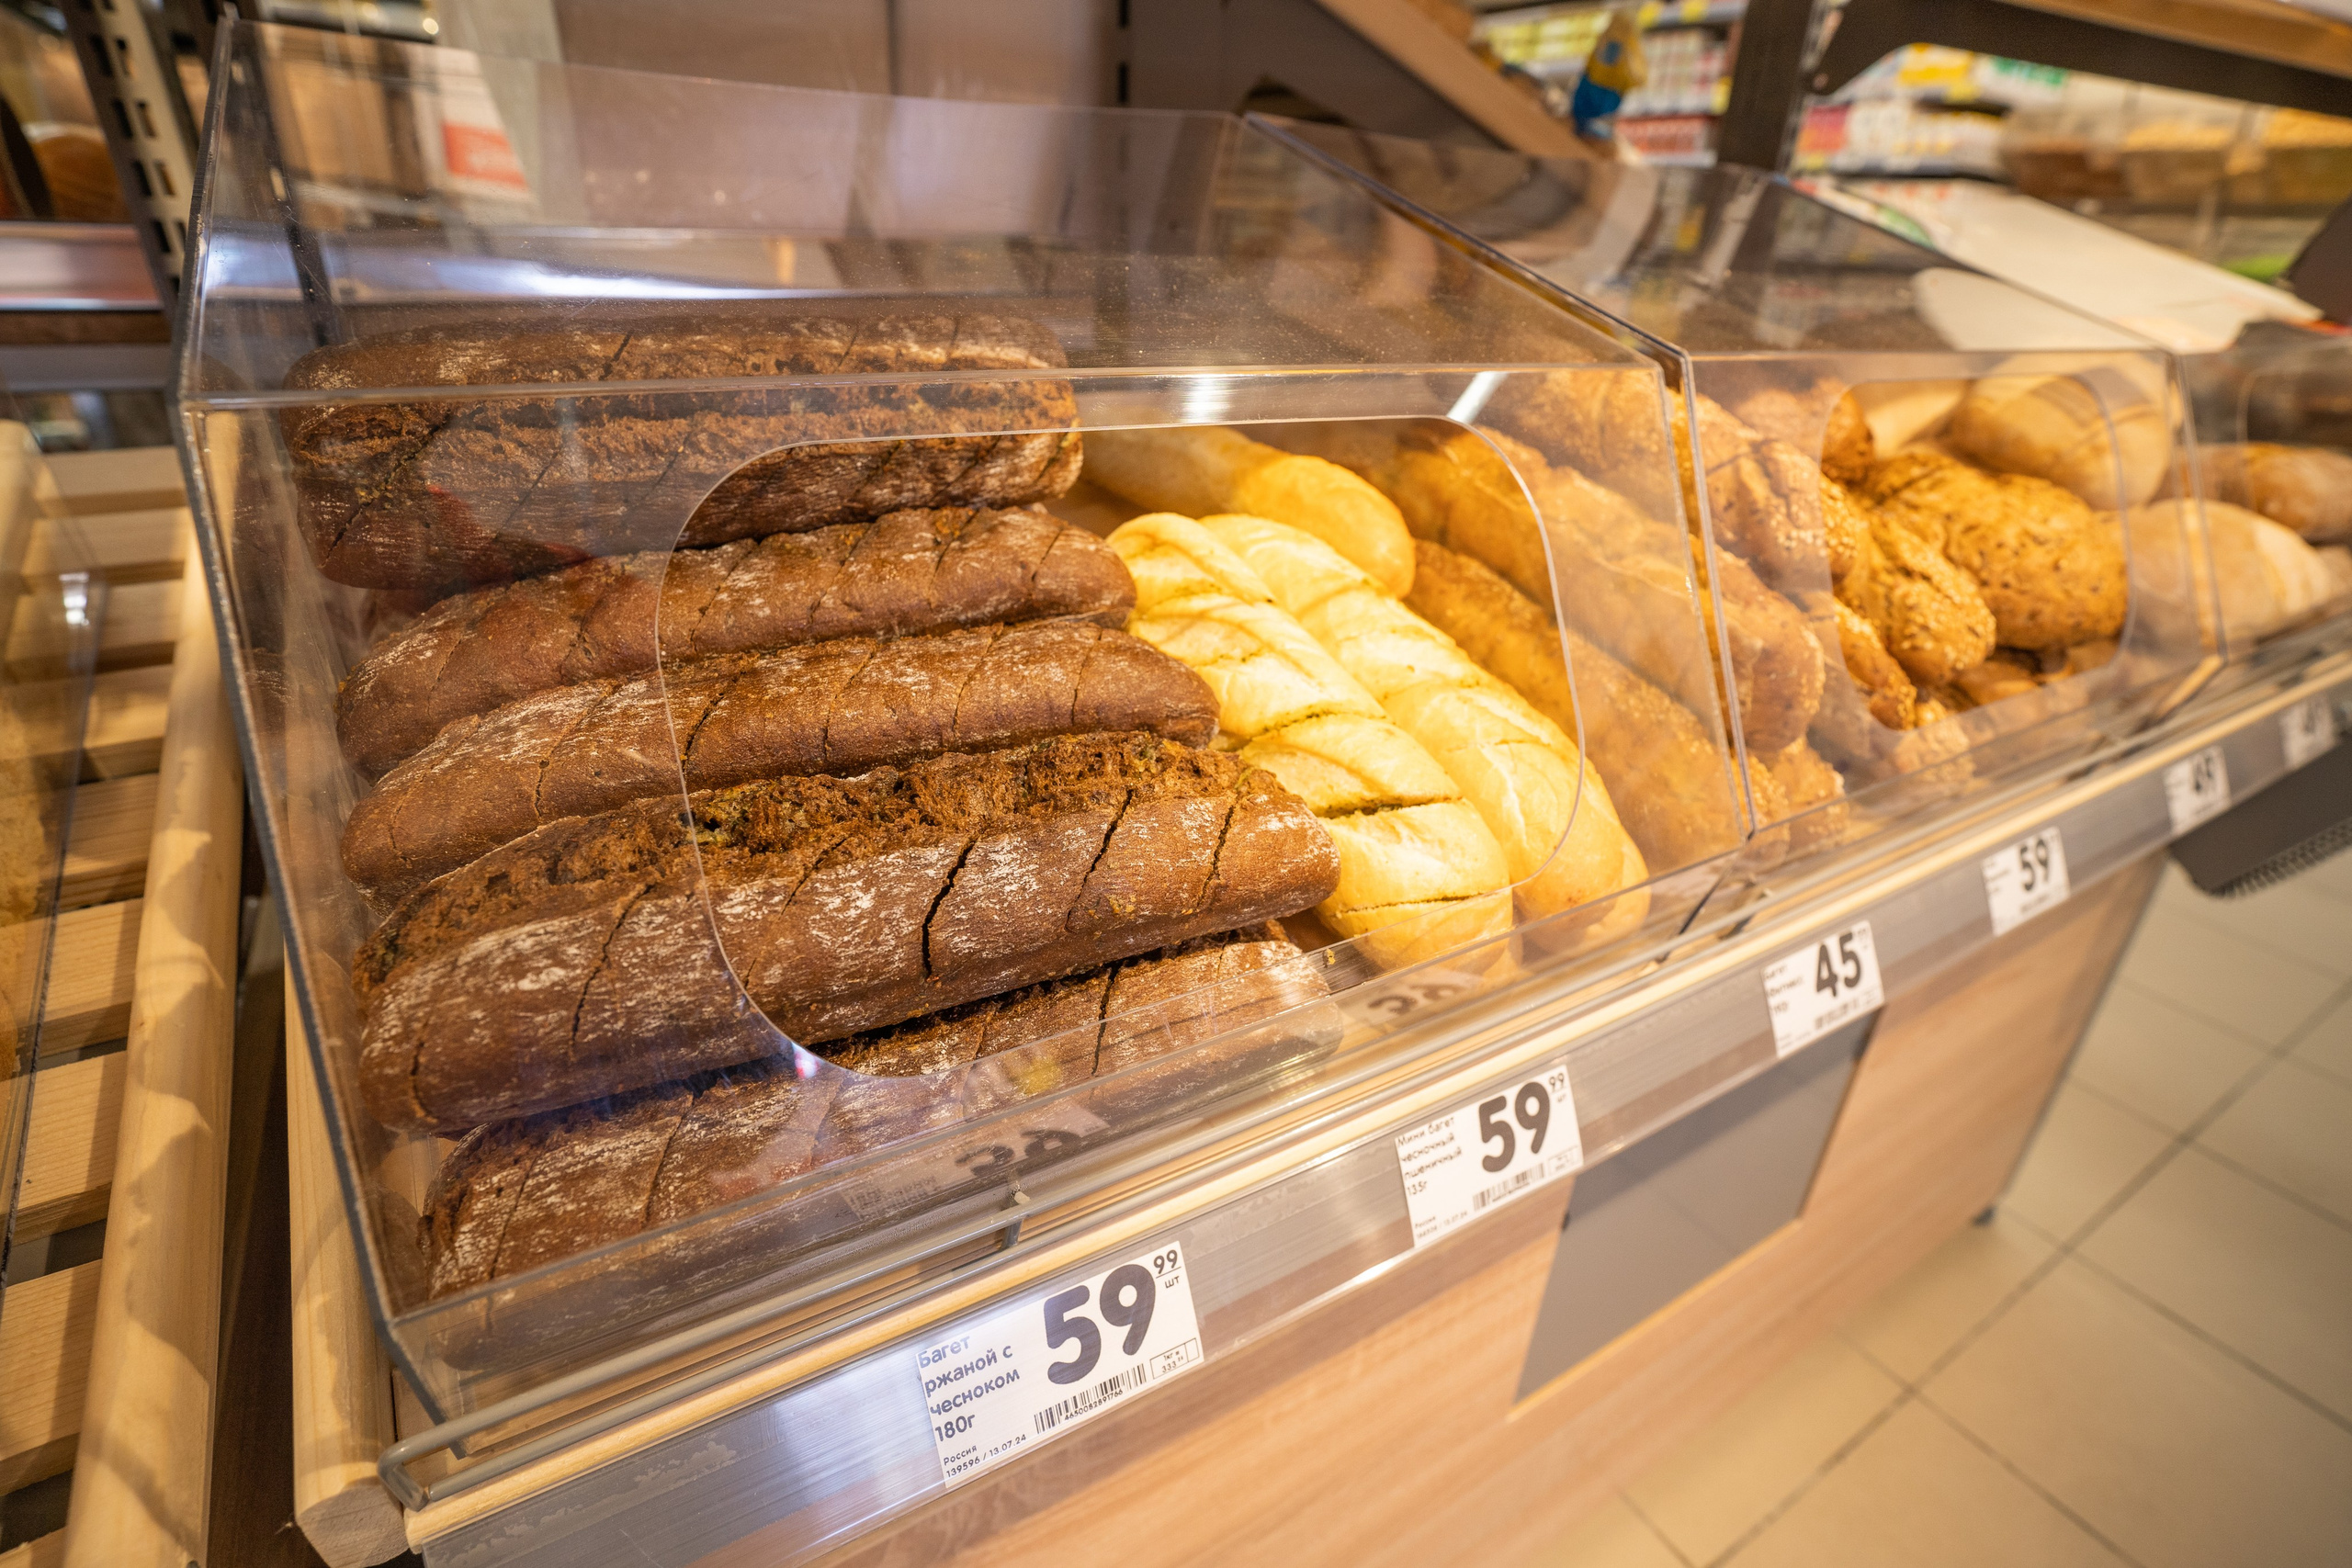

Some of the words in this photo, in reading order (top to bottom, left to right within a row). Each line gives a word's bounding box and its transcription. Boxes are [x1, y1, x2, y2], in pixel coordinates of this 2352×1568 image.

[2020, 838, 2049, 891] 59
[1816, 931, 1861, 998] 45
[1397, 1130, 1425, 1146] Мини
[1428, 1117, 1454, 1134] багет
[1478, 1081, 1550, 1173] 59
[1549, 1073, 1565, 1092] 99
[1401, 1133, 1454, 1162] чесночный
[1405, 1146, 1463, 1179] пшеничный
[1407, 1180, 1428, 1196] 135г
[1165, 1276, 1180, 1289] шт
[1044, 1264, 1157, 1384] 59
[1153, 1249, 1178, 1274] 99
[918, 1337, 970, 1369] Багет
[924, 1348, 998, 1398] ржаной
[1002, 1346, 1013, 1359] с
[930, 1369, 1020, 1416] чесноком
[935, 1415, 976, 1442] 180г
[944, 1445, 977, 1466] Россия
[946, 1458, 980, 1478] 139596
[989, 1434, 1026, 1457] 13.07.24
